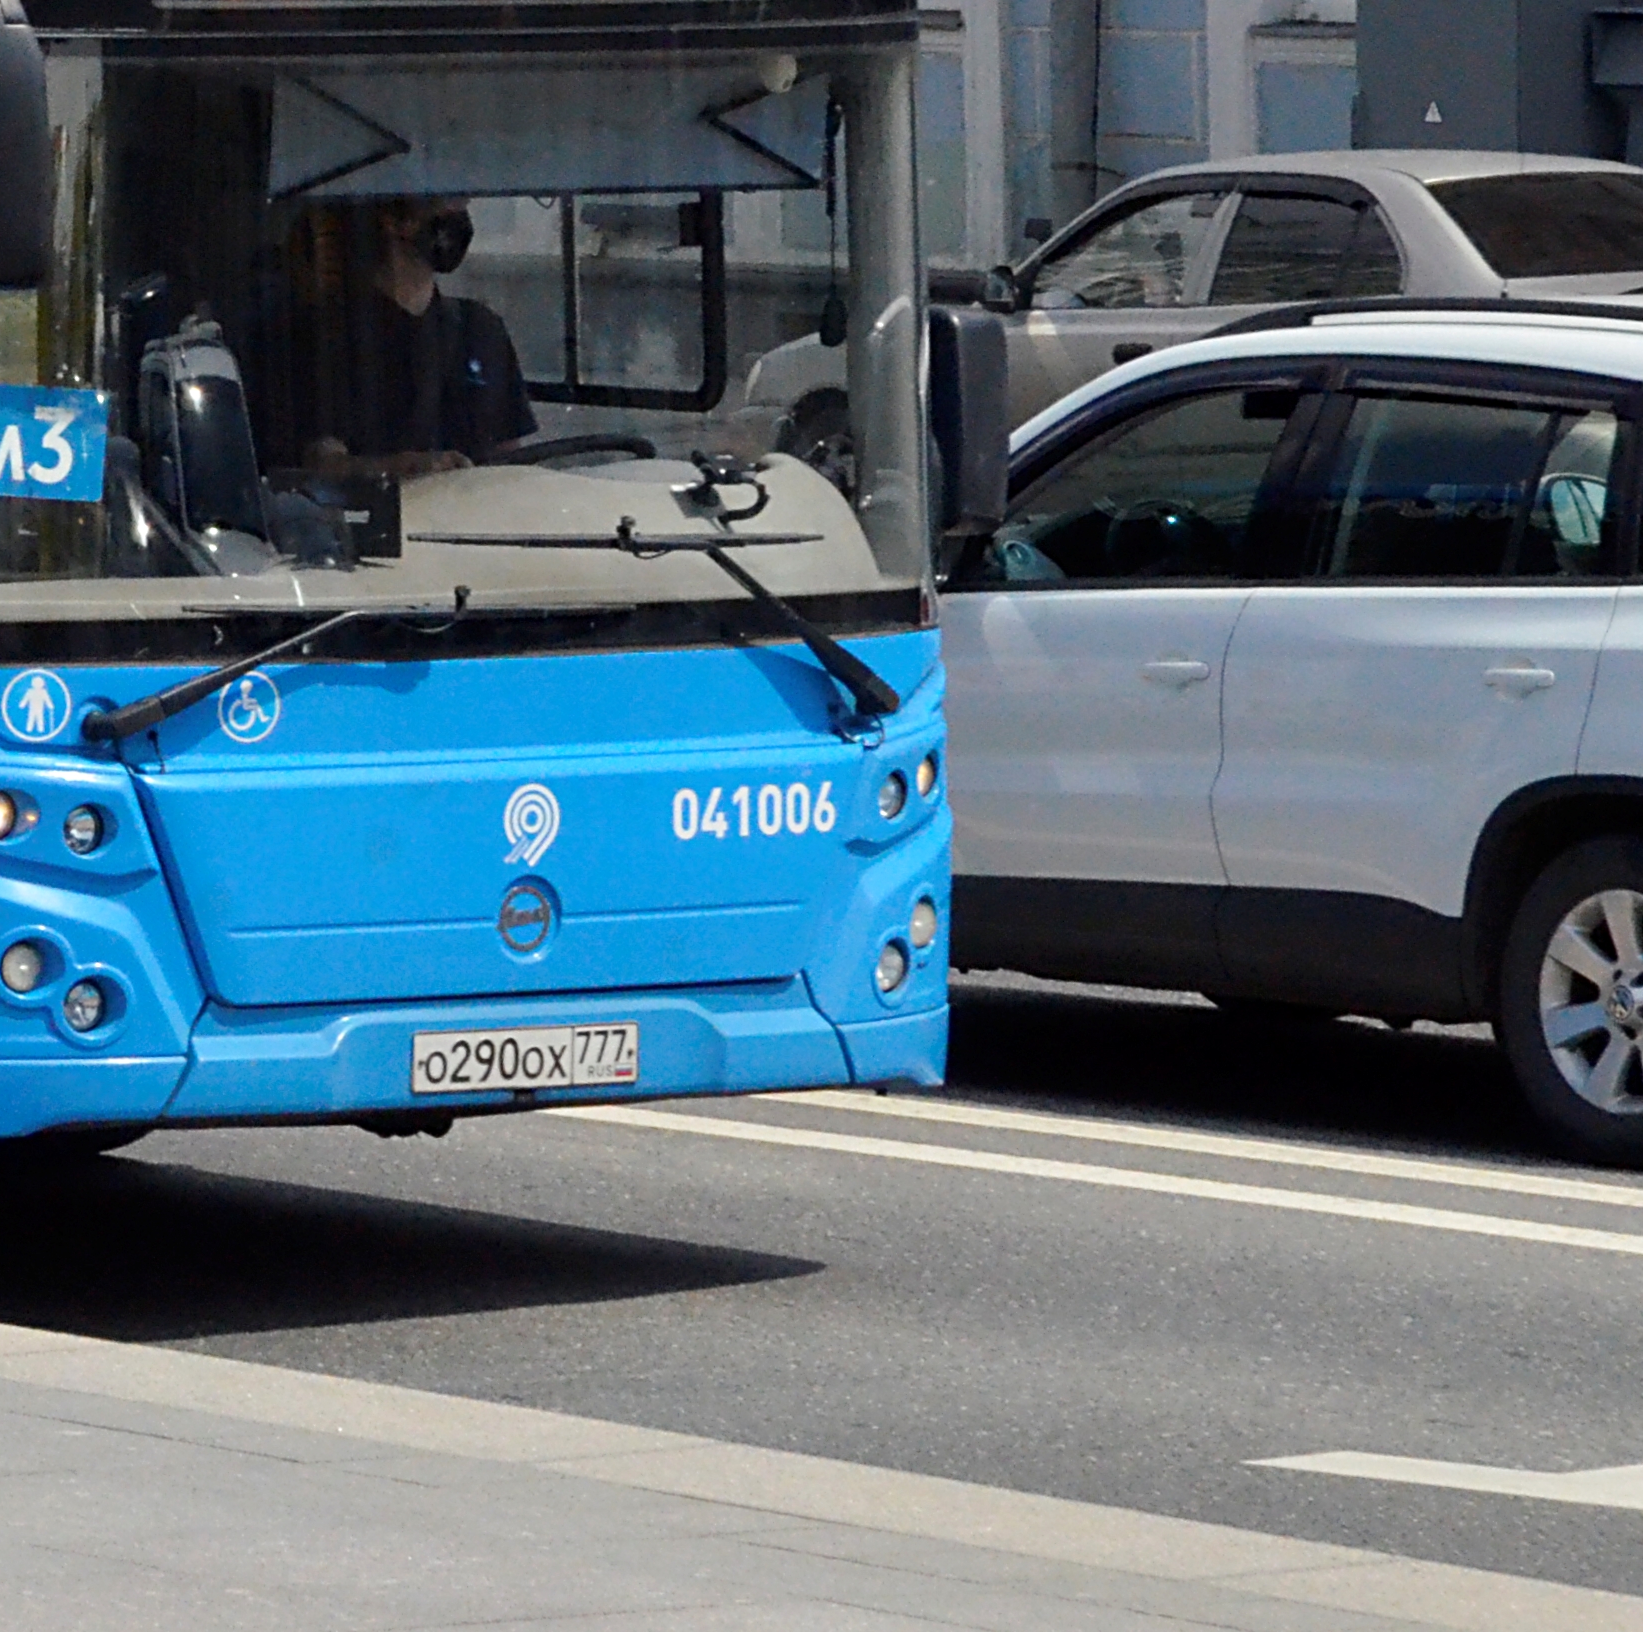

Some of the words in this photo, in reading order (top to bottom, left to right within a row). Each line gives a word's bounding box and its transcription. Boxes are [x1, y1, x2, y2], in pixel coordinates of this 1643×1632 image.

[672, 780, 837, 841] 041006
[575, 1028, 628, 1065] 777
[587, 1064, 615, 1079] RUS
